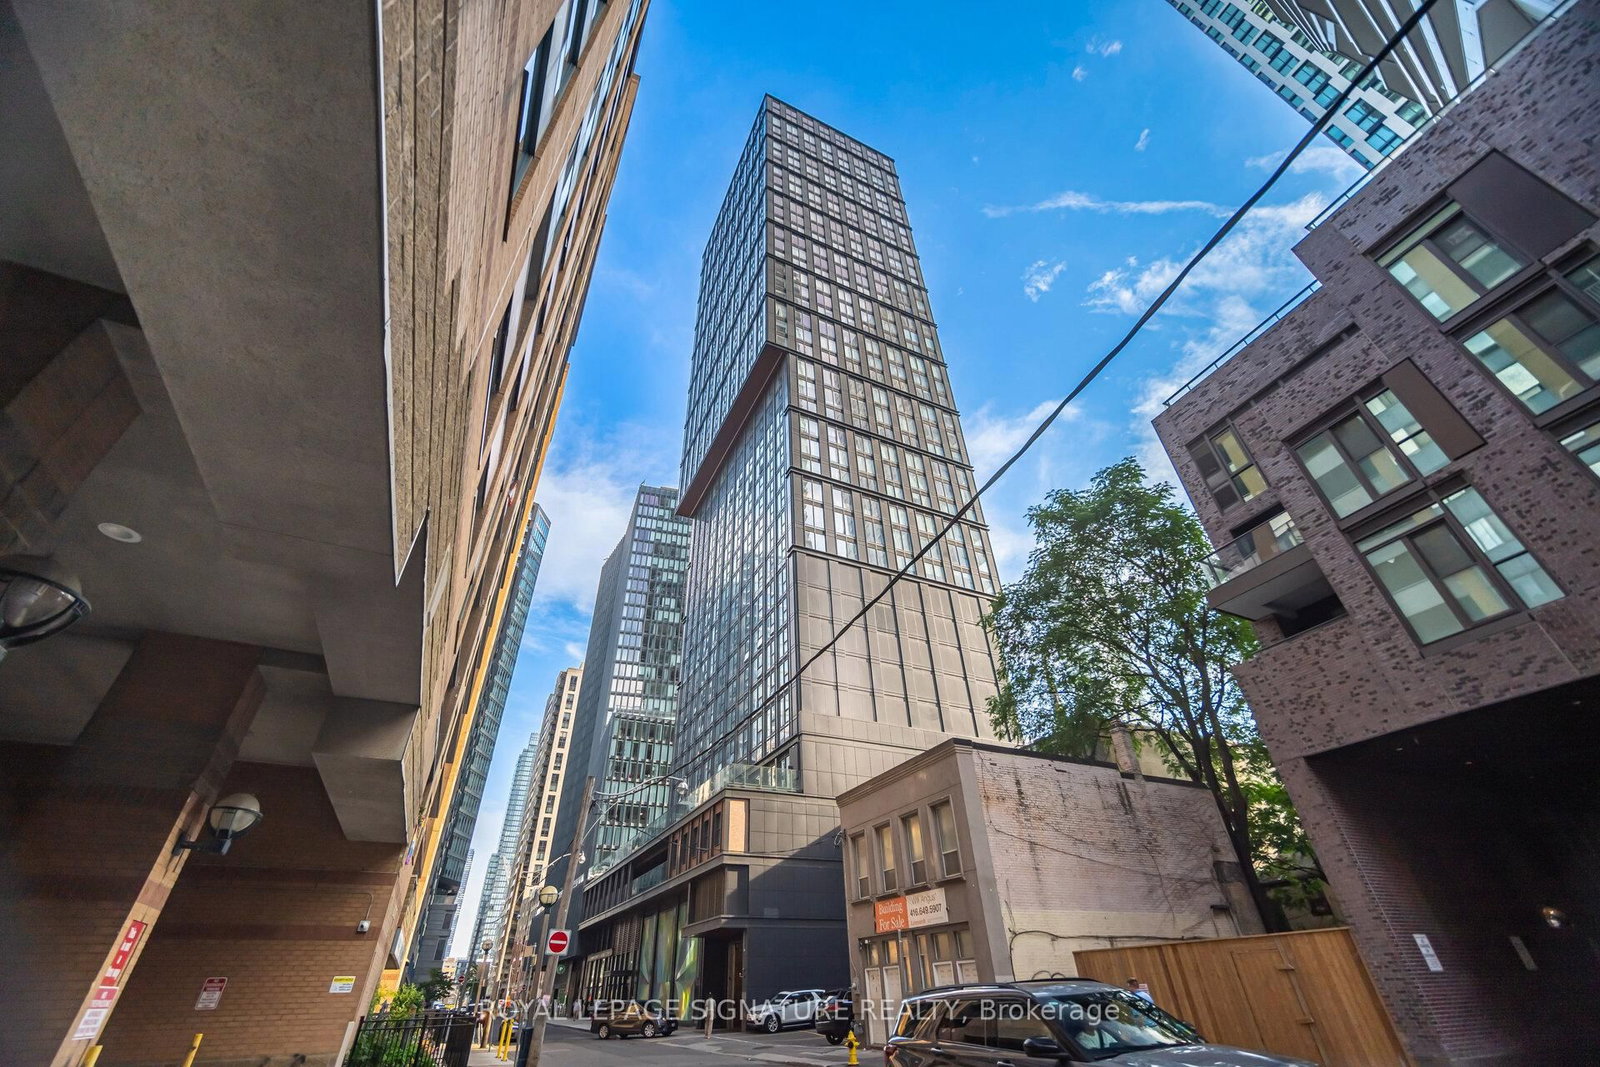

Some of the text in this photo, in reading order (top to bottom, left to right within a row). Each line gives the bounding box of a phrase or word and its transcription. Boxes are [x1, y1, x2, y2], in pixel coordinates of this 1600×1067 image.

[878, 901, 903, 915] Building
[879, 919, 890, 931] For
[891, 915, 905, 929] Sale
